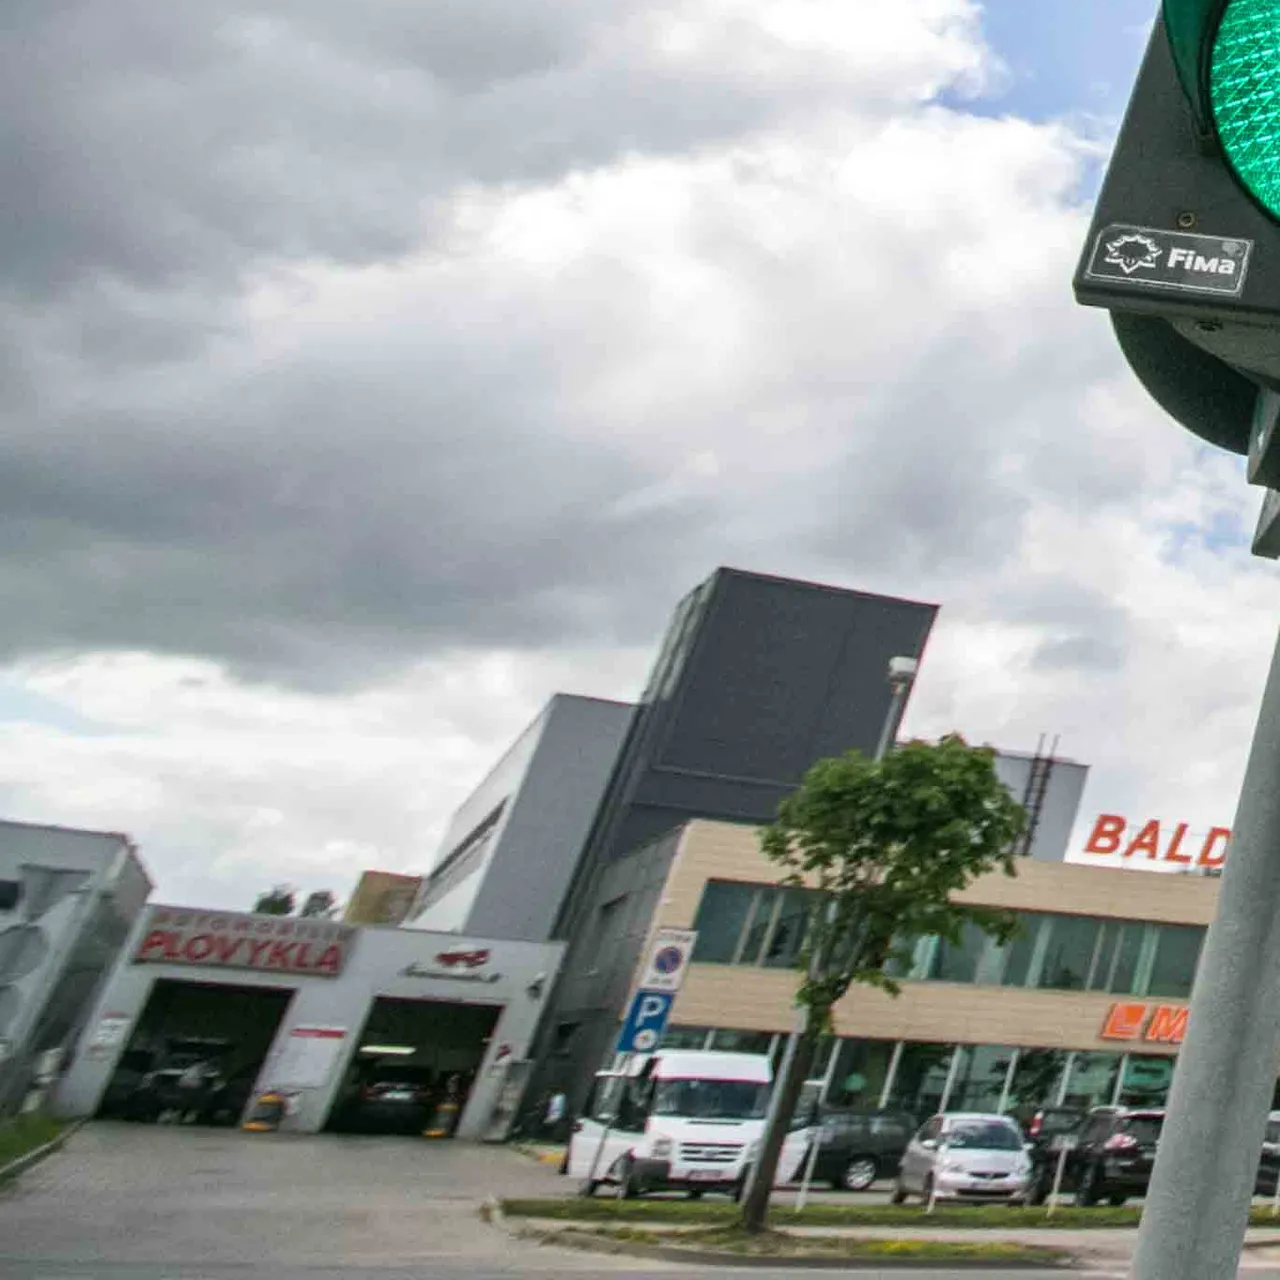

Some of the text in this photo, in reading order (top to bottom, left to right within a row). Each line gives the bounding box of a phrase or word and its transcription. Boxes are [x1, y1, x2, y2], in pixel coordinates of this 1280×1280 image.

[1084, 814, 1232, 868] BALD
[136, 928, 344, 972] PLOVYKLA
[635, 996, 667, 1027] P
